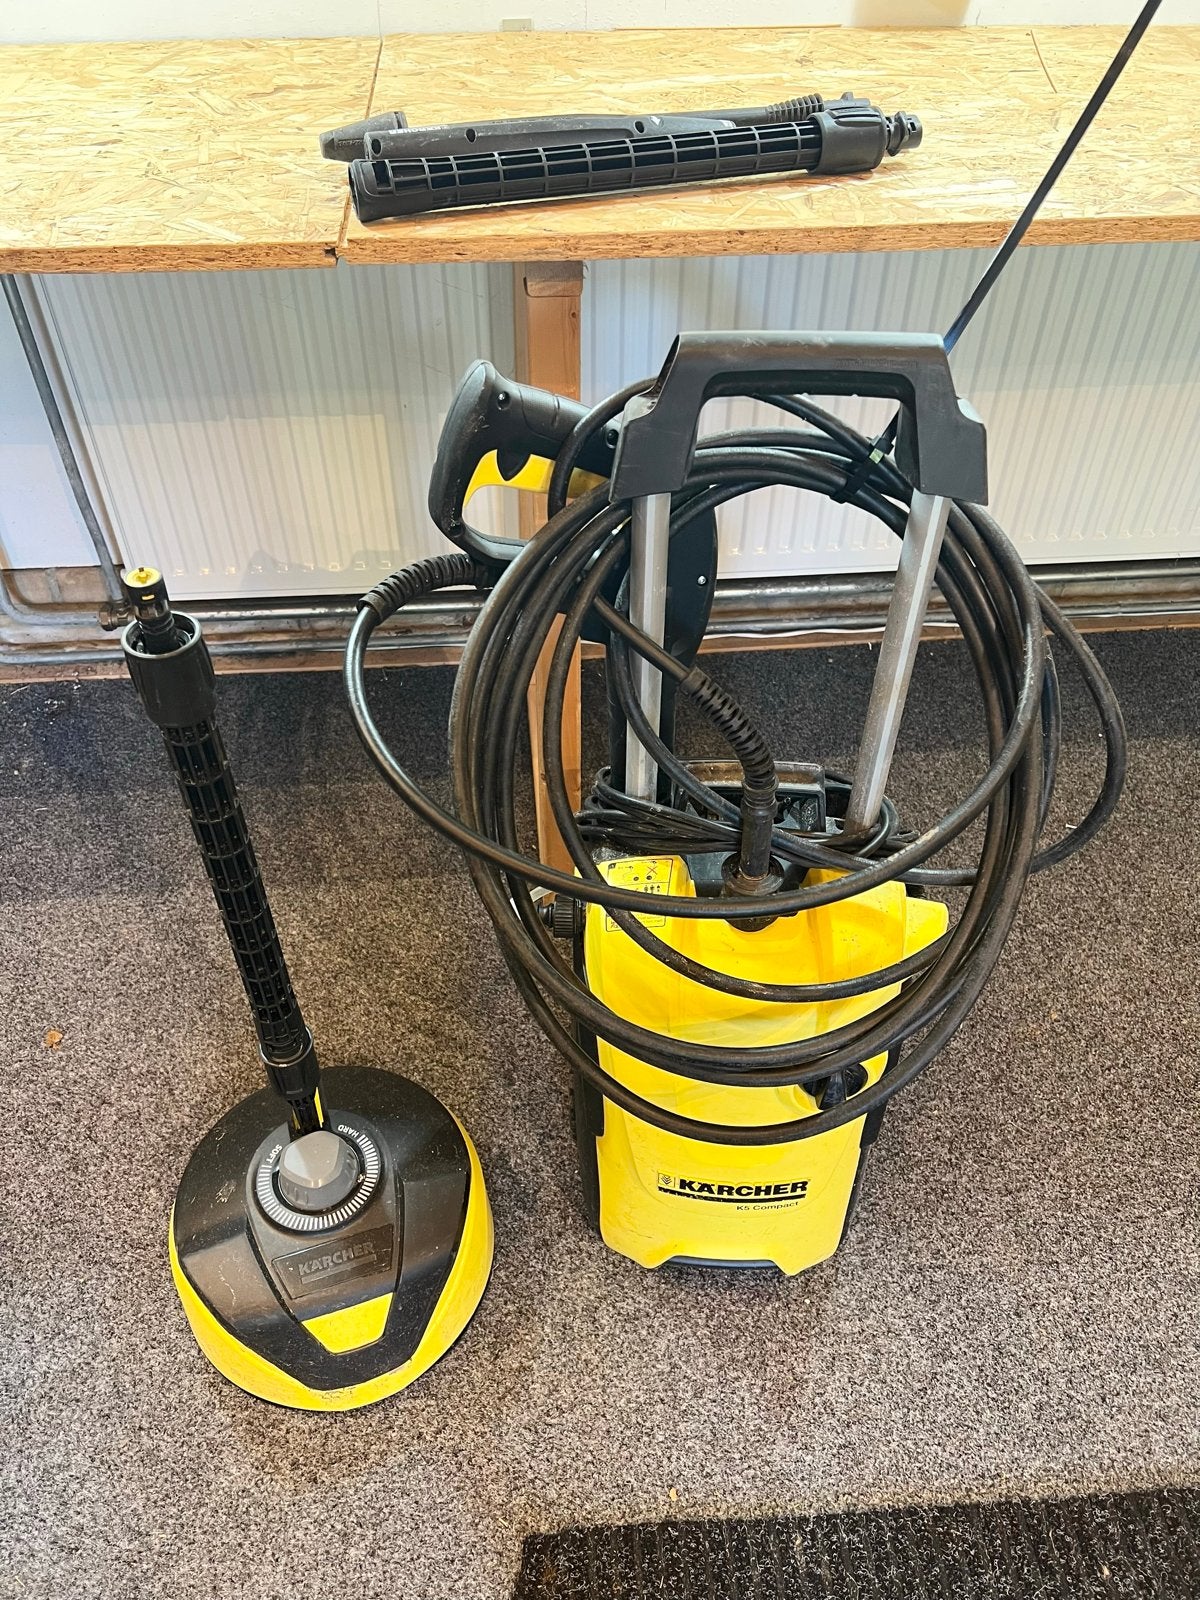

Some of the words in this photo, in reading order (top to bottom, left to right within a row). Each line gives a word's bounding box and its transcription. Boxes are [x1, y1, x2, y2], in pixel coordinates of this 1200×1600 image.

[338, 1124, 359, 1138] HARD
[266, 1144, 283, 1164] SOFT
[679, 1179, 809, 1197] KÄRCHER
[753, 1201, 799, 1211] Compact
